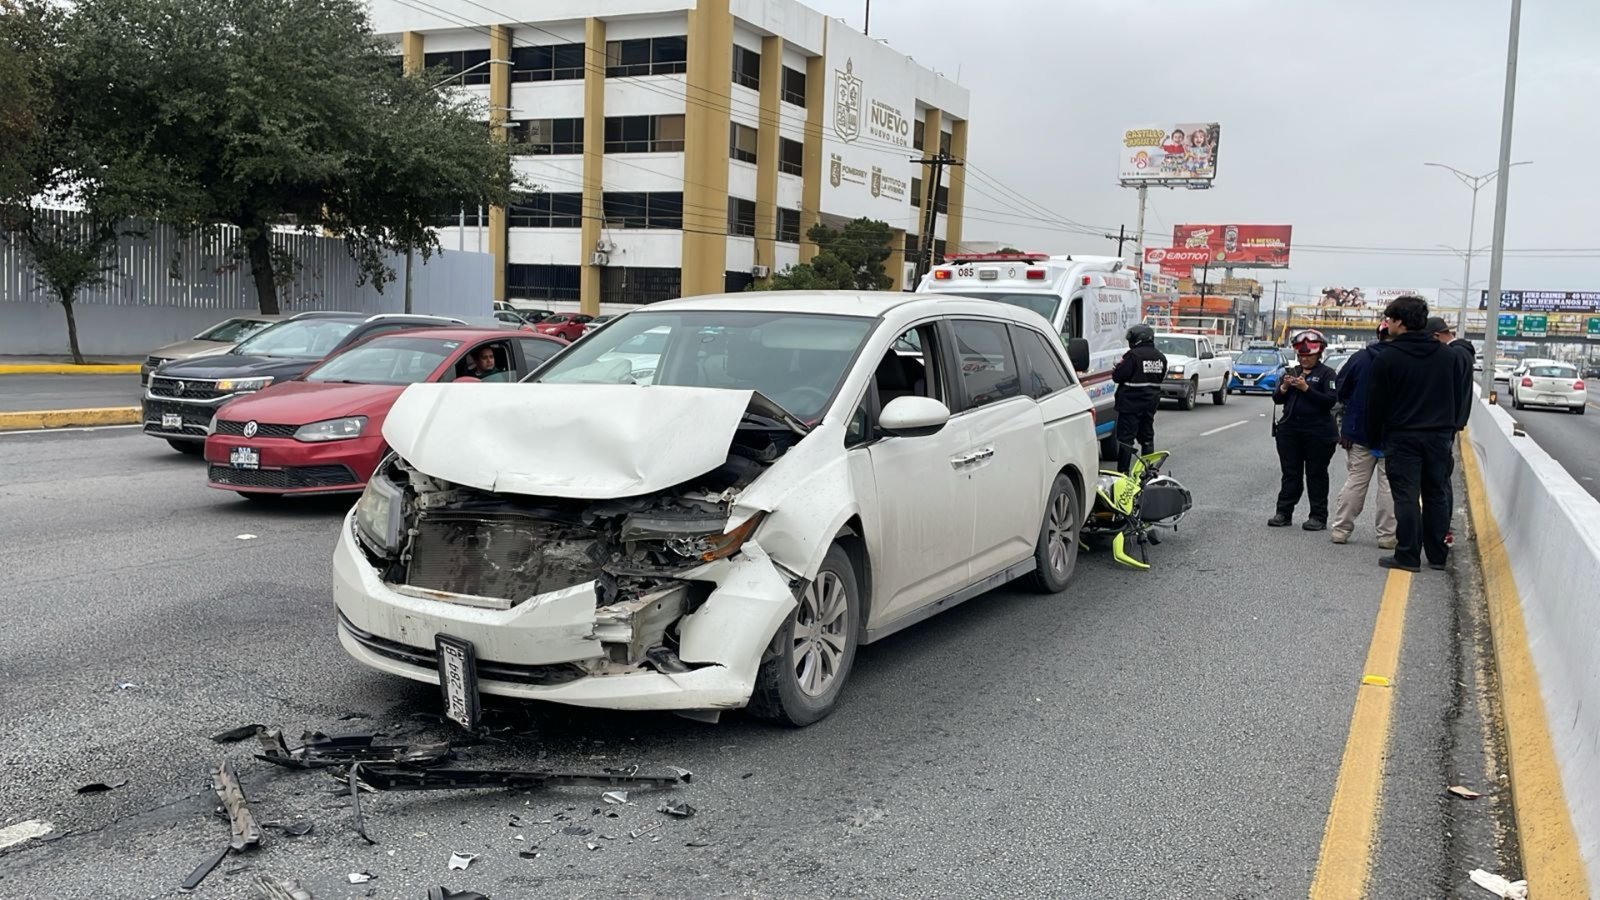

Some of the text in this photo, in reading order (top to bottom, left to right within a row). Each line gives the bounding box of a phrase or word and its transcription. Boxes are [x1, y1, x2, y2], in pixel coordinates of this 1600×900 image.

[871, 105, 908, 136] NUEVO
[870, 127, 890, 141] NUEVO
[1126, 129, 1165, 138] CASTILLO
[1166, 252, 1209, 260] EMOTION
[958, 268, 974, 277] 085
[1101, 311, 1118, 325] SALUD
[1142, 359, 1164, 367] POLICÍA
